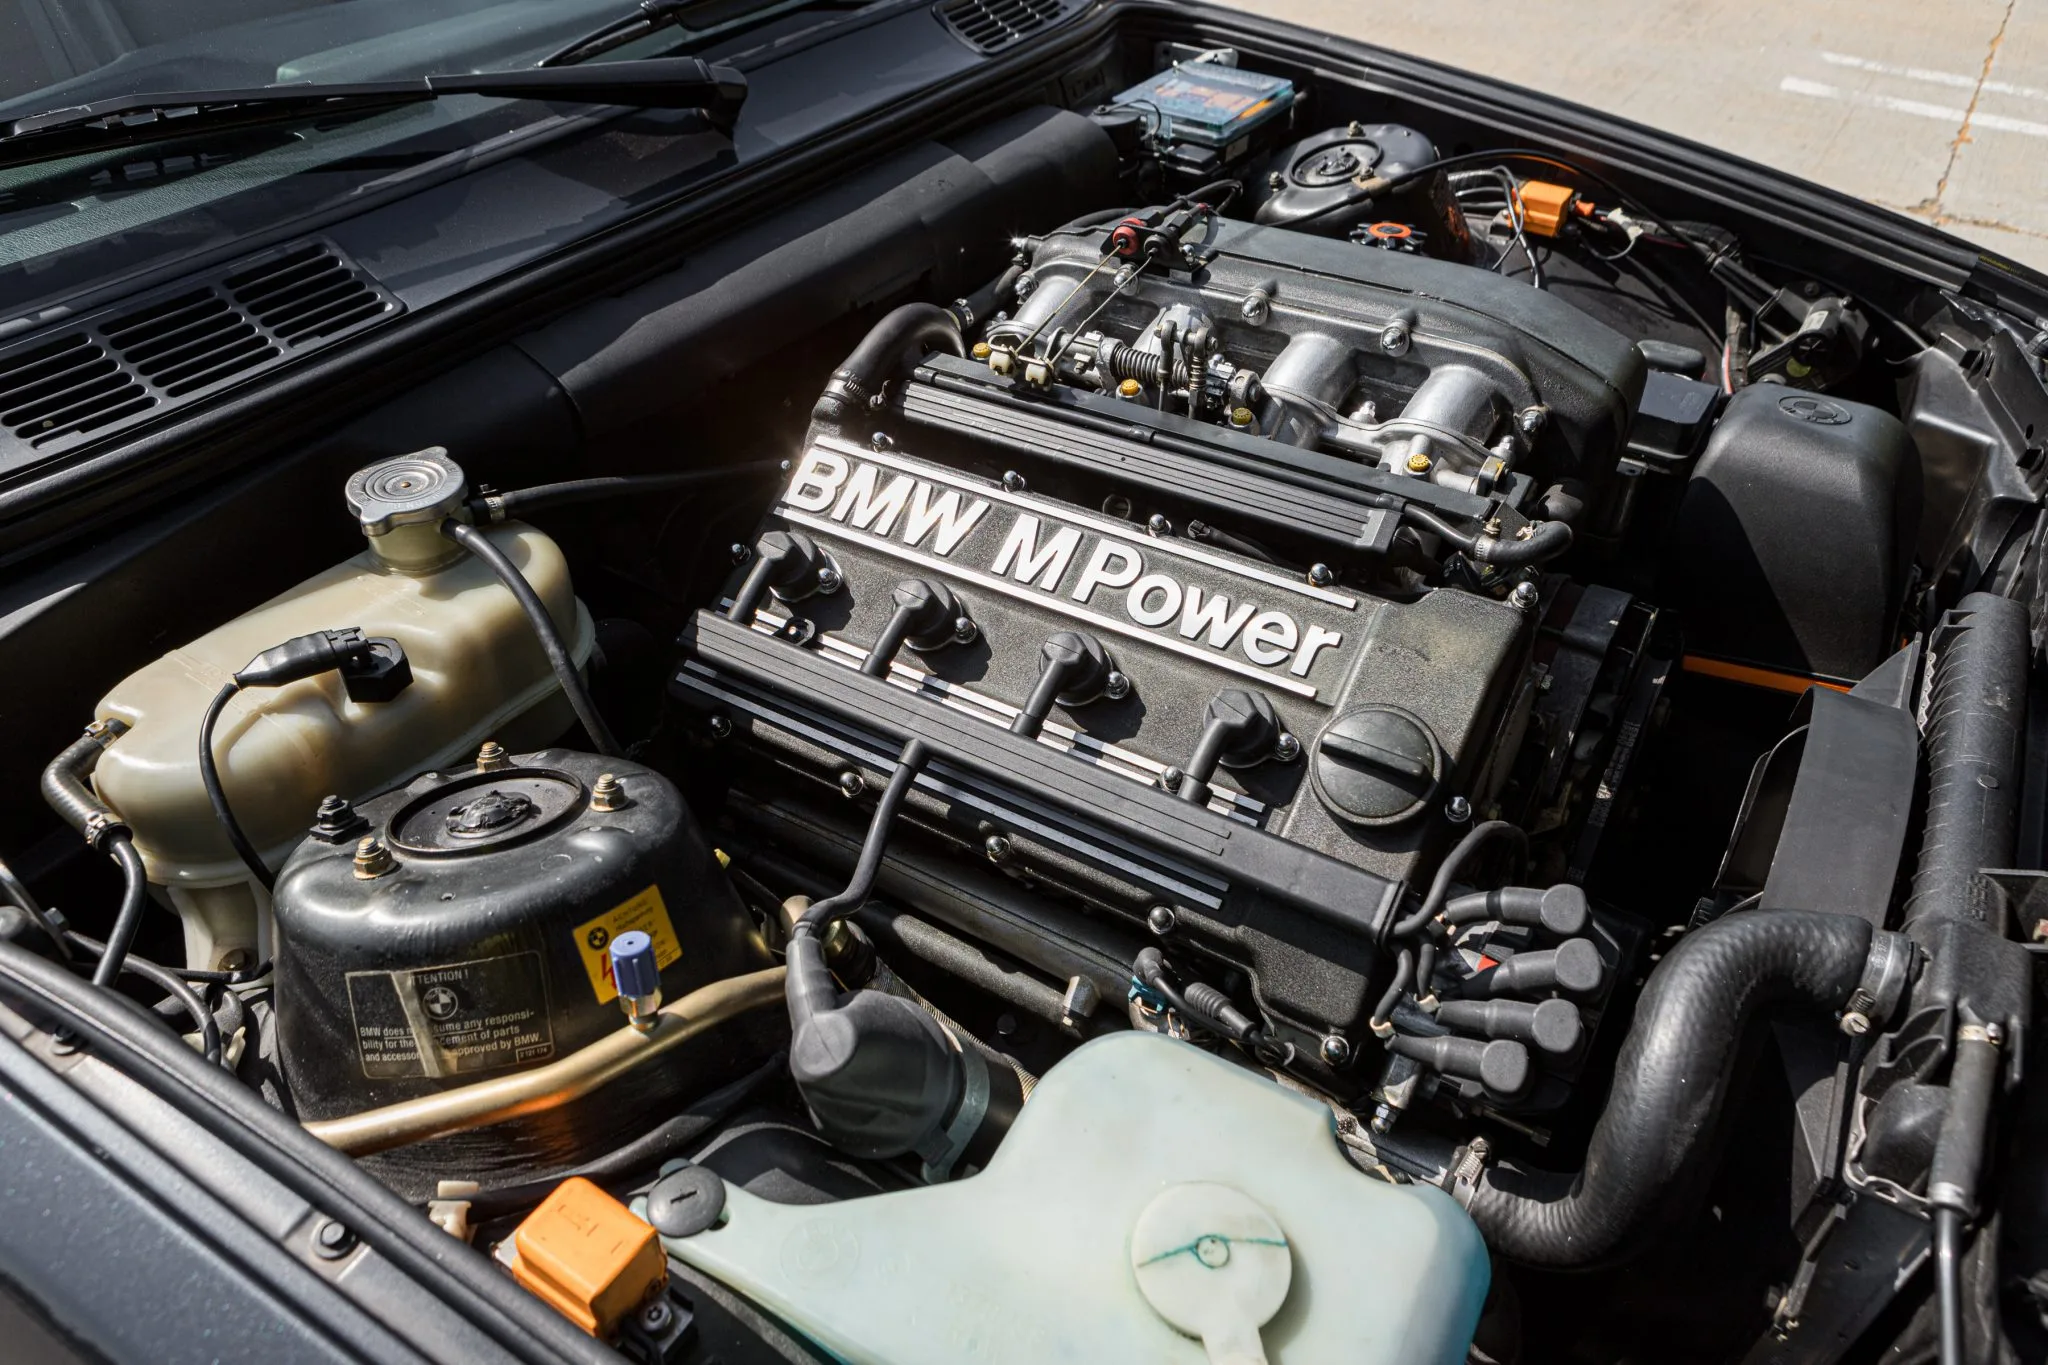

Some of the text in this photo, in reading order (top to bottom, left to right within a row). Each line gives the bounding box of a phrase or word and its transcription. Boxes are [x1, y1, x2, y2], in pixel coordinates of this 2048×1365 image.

[785, 447, 991, 556] BMW
[360, 1026, 381, 1037] BMW
[383, 1027, 405, 1036] does
[432, 1022, 461, 1033] sume
[464, 1018, 482, 1030] any
[485, 1009, 534, 1026] responsi-
[362, 1039, 383, 1051] bility
[385, 1039, 398, 1049] for
[400, 1038, 414, 1048] the
[480, 1030, 490, 1040] of
[493, 1025, 520, 1040] parts
[365, 1052, 380, 1062] and
[500, 1040, 512, 1050] by
